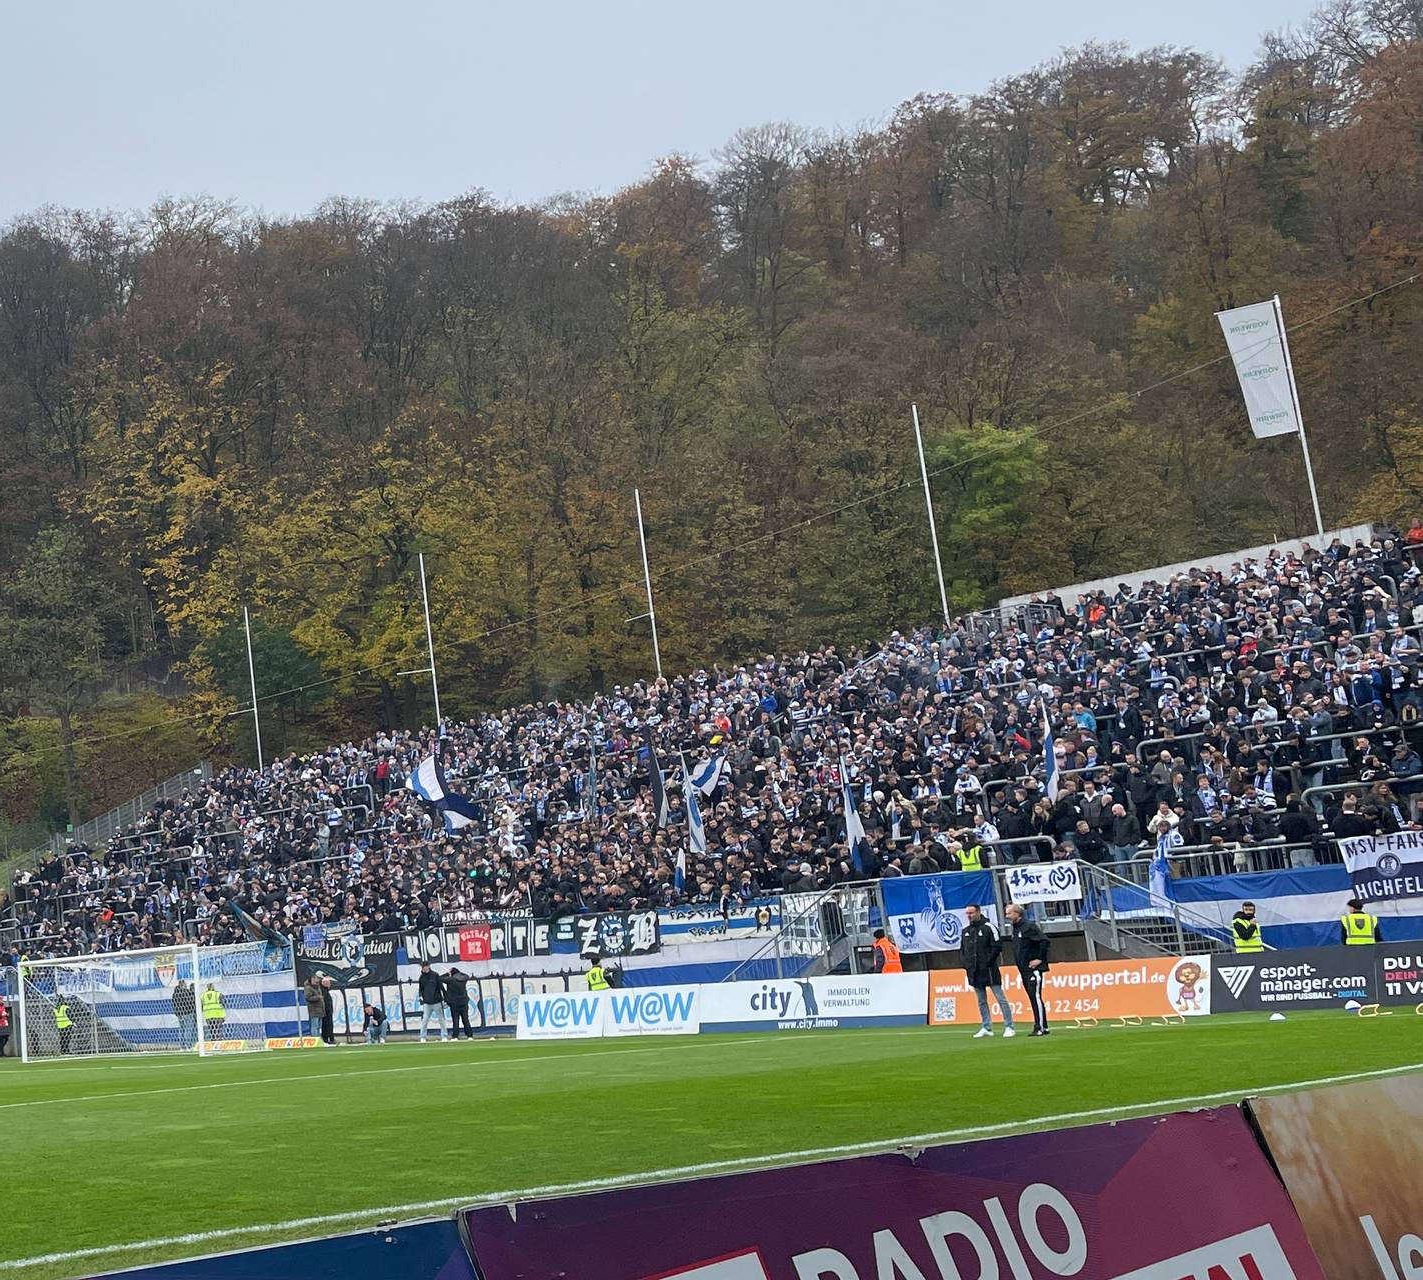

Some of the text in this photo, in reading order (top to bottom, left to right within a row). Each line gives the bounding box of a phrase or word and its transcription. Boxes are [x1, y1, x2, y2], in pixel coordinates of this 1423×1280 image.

[1010, 868, 1042, 887] 45er
[406, 919, 549, 959] KOHRTE
[332, 940, 393, 960] Gation
[1384, 957, 1411, 969] DU
[1260, 964, 1316, 980] esport-
[1385, 971, 1417, 980] DEIN
[1261, 975, 1366, 993] manager.com
[1385, 983, 1401, 995] 11
[750, 984, 870, 1017] city IMMOBILIEN
[823, 997, 870, 1008] VERWALTUNG
[1261, 994, 1275, 1002] WIR
[1276, 993, 1293, 1001] SIND
[1294, 992, 1333, 1001] FUSSBALL
[1338, 990, 1367, 998] DIGITAL
[524, 997, 599, 1028] W@W
[611, 992, 695, 1025] W@W
[992, 1001, 1023, 1015] 002
[1054, 1000, 1071, 1012] 22
[1073, 999, 1099, 1012] 454
[778, 1018, 839, 1030] www.city.immo
